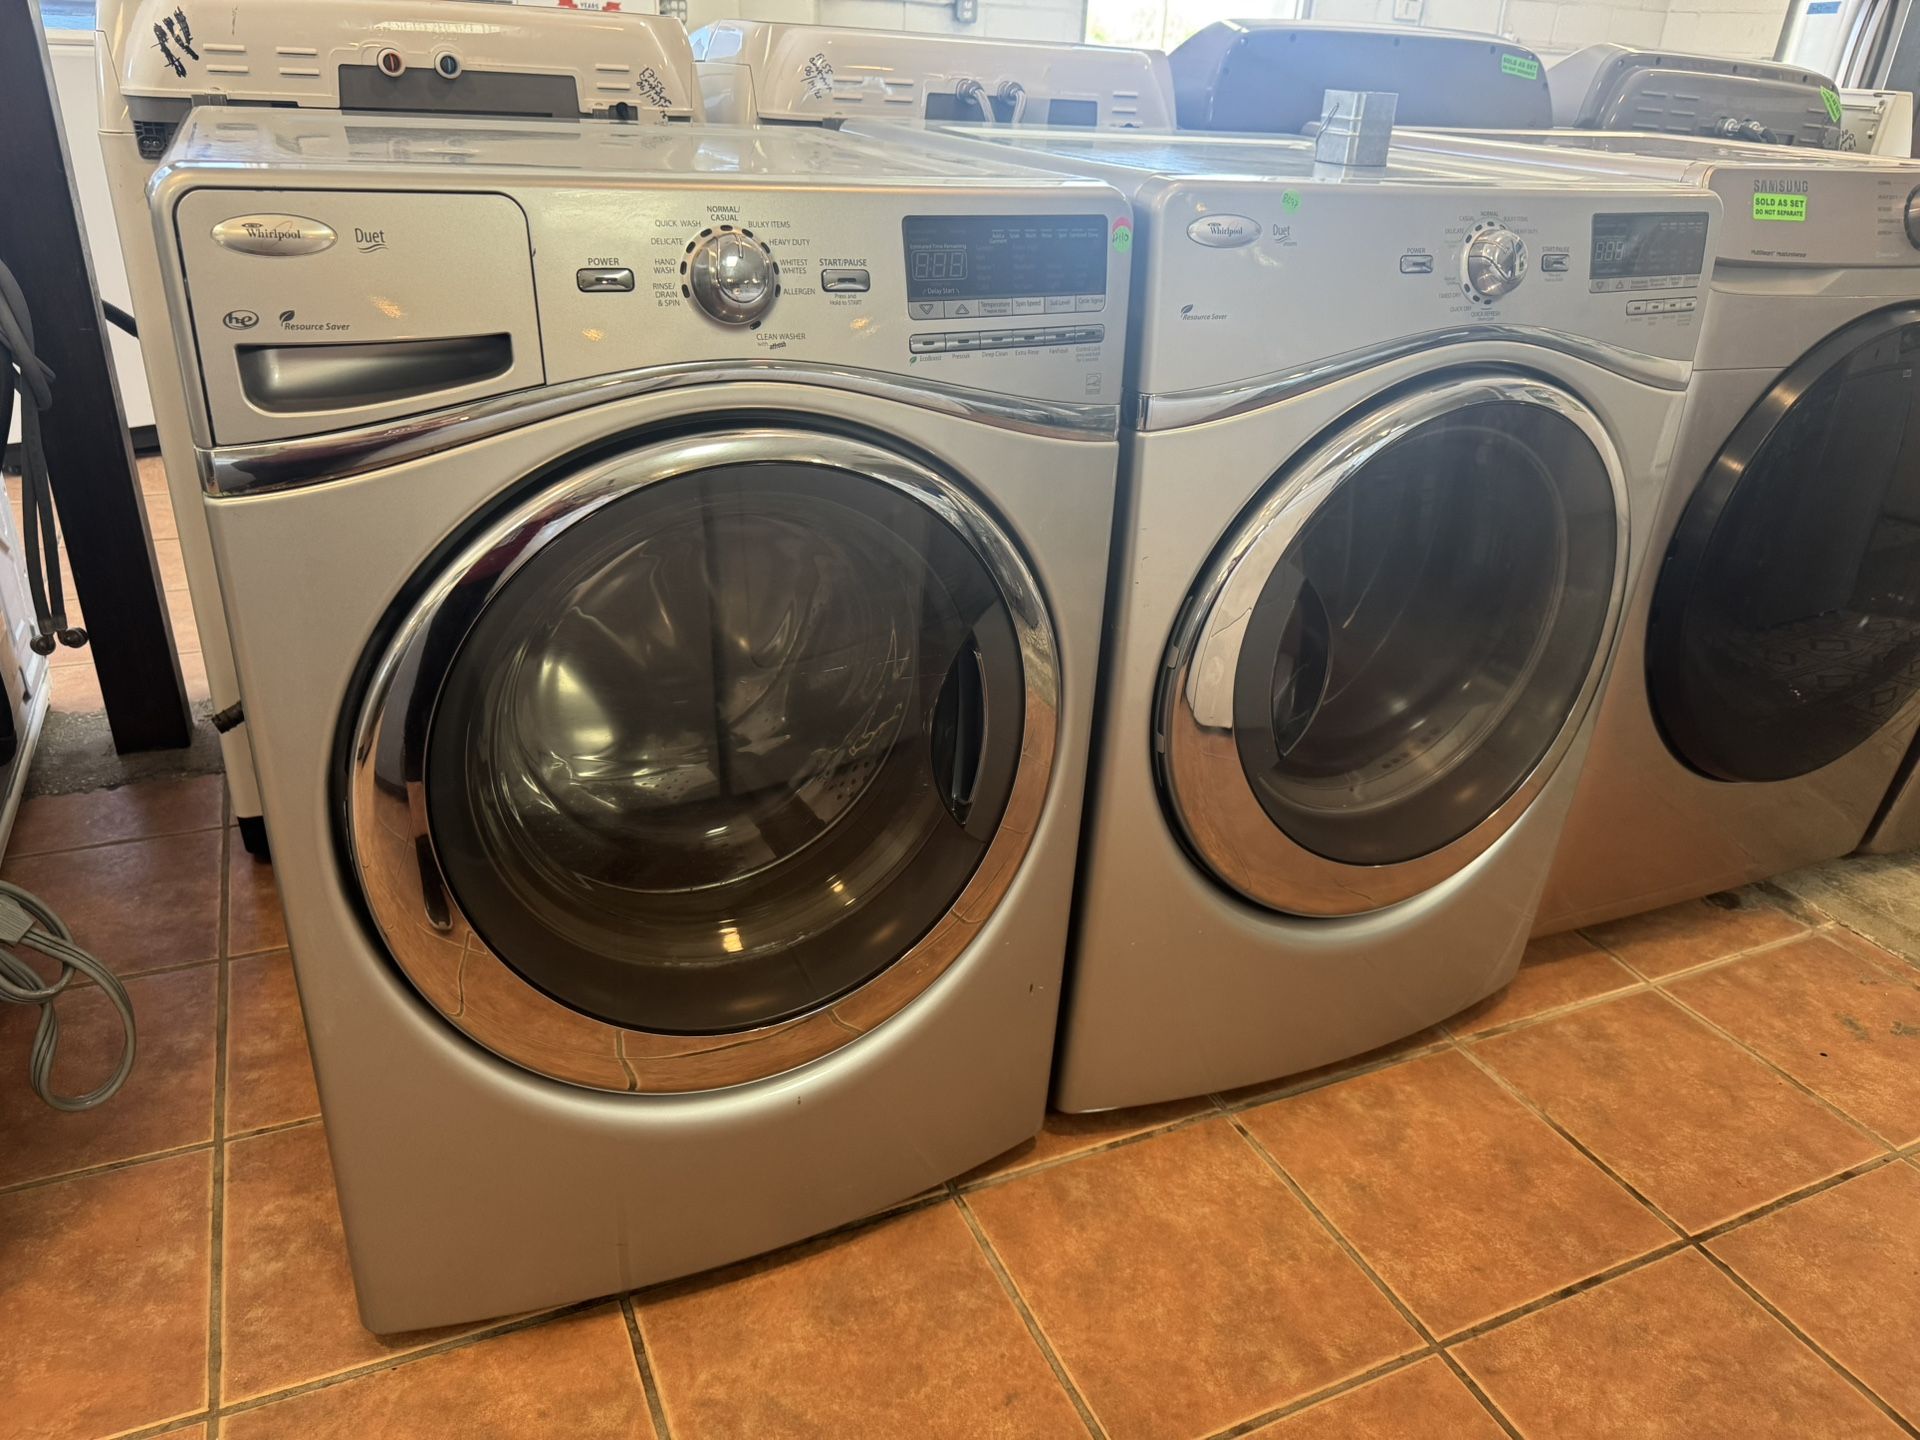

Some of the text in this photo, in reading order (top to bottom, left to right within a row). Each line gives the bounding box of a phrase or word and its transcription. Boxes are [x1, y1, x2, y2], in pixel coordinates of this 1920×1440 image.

[1753, 179, 1808, 193] SAMSUNG
[1755, 198, 1775, 206] SOLD
[1790, 200, 1804, 208] SET
[707, 205, 741, 213] NORMAL/
[711, 214, 739, 222] CASUAL
[655, 219, 701, 228] QUICK WASH
[748, 220, 791, 229] BULKY ITEMS
[1210, 226, 1243, 237] Whirlpool
[1273, 224, 1290, 236] Duet
[246, 228, 301, 241] Whirlpool
[355, 227, 386, 243] Duet
[650, 238, 684, 246] DELICATE
[769, 238, 811, 247] HEAVY DUTY
[588, 258, 620, 266] POWER
[654, 258, 676, 266] HAND
[780, 259, 808, 267] WHITEST
[819, 257, 867, 267] START/PAUSE
[782, 267, 807, 275] WHITES
[652, 282, 675, 290] RINSE/
[655, 291, 678, 299] DRAIN
[783, 288, 816, 296] ALLERGEN
[927, 287, 955, 296] Delay Start
[665, 300, 680, 308] SPIN
[980, 301, 1011, 310] Temperature
[284, 322, 350, 331] Resource Saver
[756, 333, 806, 341] CLEAN WASHER
[995, 350, 1008, 358] Clean
